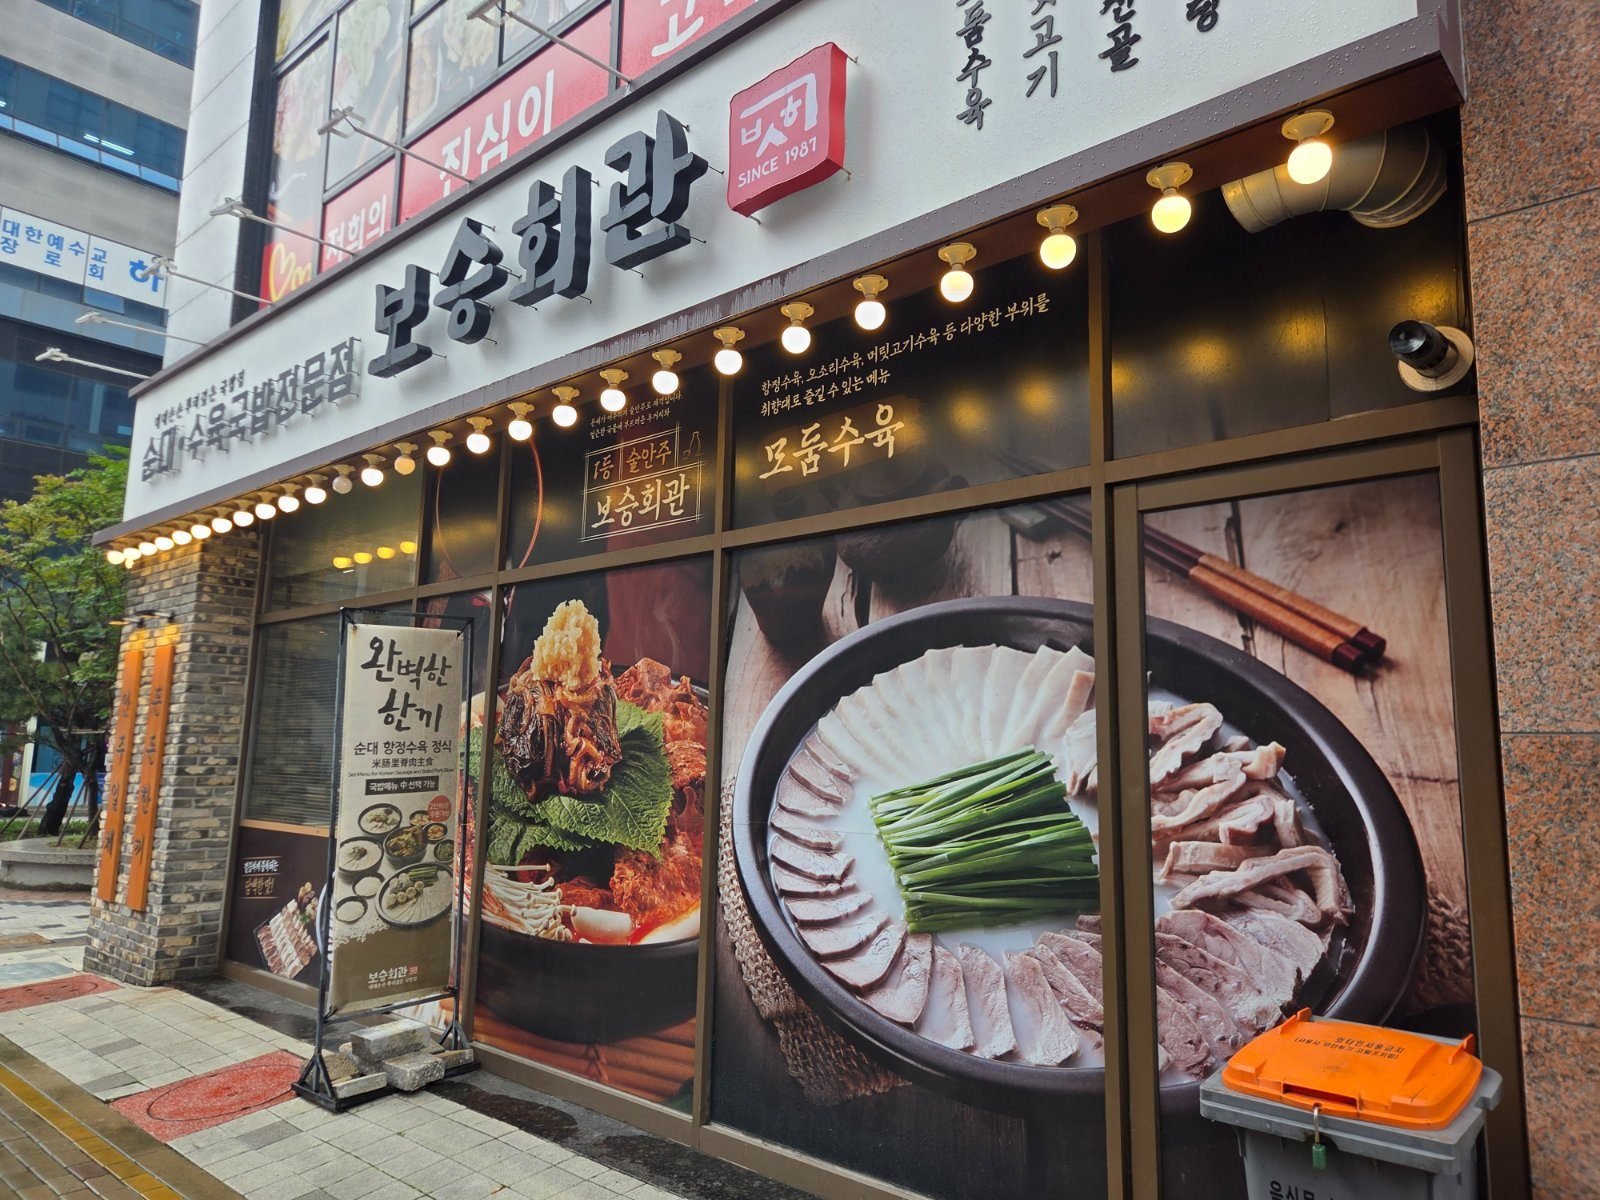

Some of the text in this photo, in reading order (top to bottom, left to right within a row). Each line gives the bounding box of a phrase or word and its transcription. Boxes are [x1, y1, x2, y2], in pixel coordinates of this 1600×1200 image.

[440, 69, 555, 197] 진심이
[738, 136, 818, 188] SINCE 1987
[326, 194, 387, 262] 저희의
[368, 109, 705, 379] 보승회관
[761, 292, 1050, 396] 항정수육, 오소리수육, 머릿고기수육 등 다양한 부위를
[760, 368, 891, 417] 취향대로 즐길 수 있는 메뉴
[593, 440, 672, 481] 1등 술안주
[759, 403, 905, 480] 모둠수육
[591, 473, 690, 528] 보승회관
[360, 636, 452, 690] 완벽한
[378, 688, 443, 733] 한끼
[354, 740, 452, 756] 순대 항정수육 정식
[369, 782, 399, 792] 국밥메뉴
[408, 780, 422, 790] 선택
[423, 779, 436, 788] 가능
[368, 965, 408, 984] 보승회관
